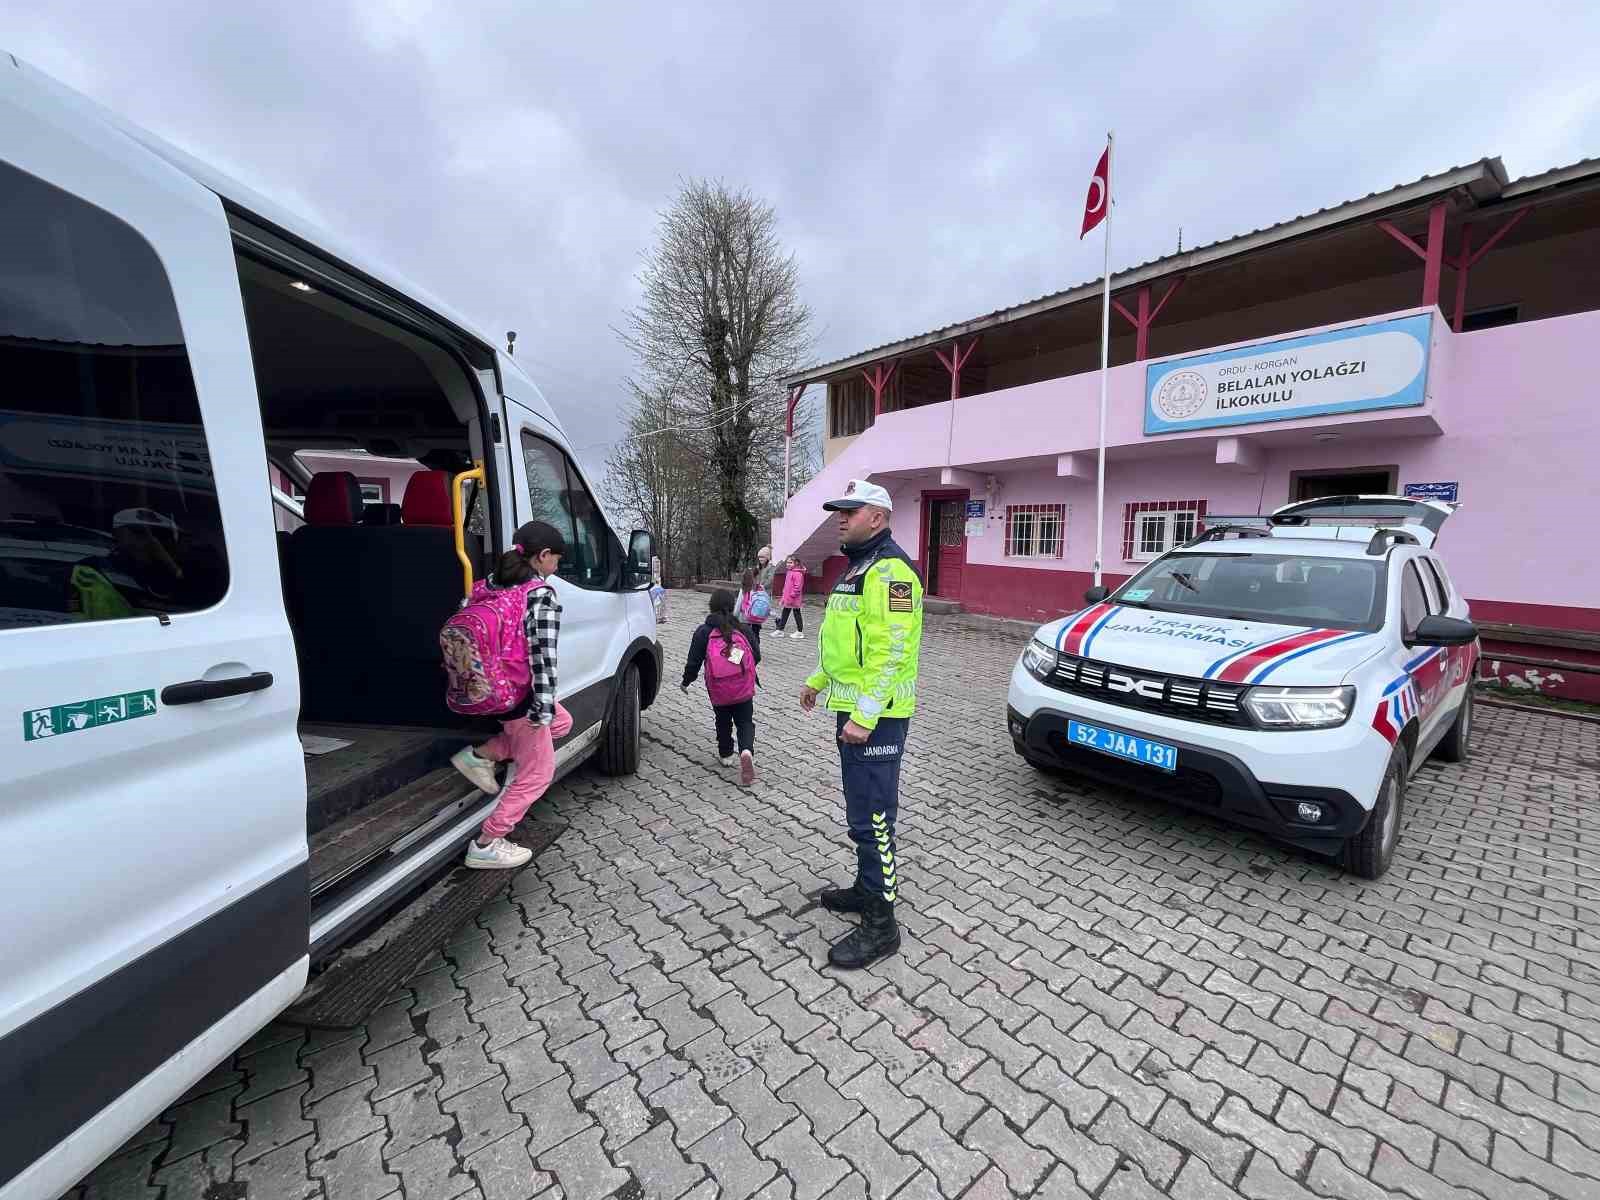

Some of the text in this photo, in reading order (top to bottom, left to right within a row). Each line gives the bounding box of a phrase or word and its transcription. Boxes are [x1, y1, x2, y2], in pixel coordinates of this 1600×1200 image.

[1217, 360, 1366, 394] BELALAN YOLAĞZI
[1218, 366, 1247, 377] ORDU
[1254, 356, 1298, 371] KORGAN
[1216, 389, 1293, 410] İLKOKULU
[1105, 624, 1254, 648] JANDARMASI
[863, 744, 899, 756] JANDARMA
[1077, 724, 1174, 767] 52 JAA 131
